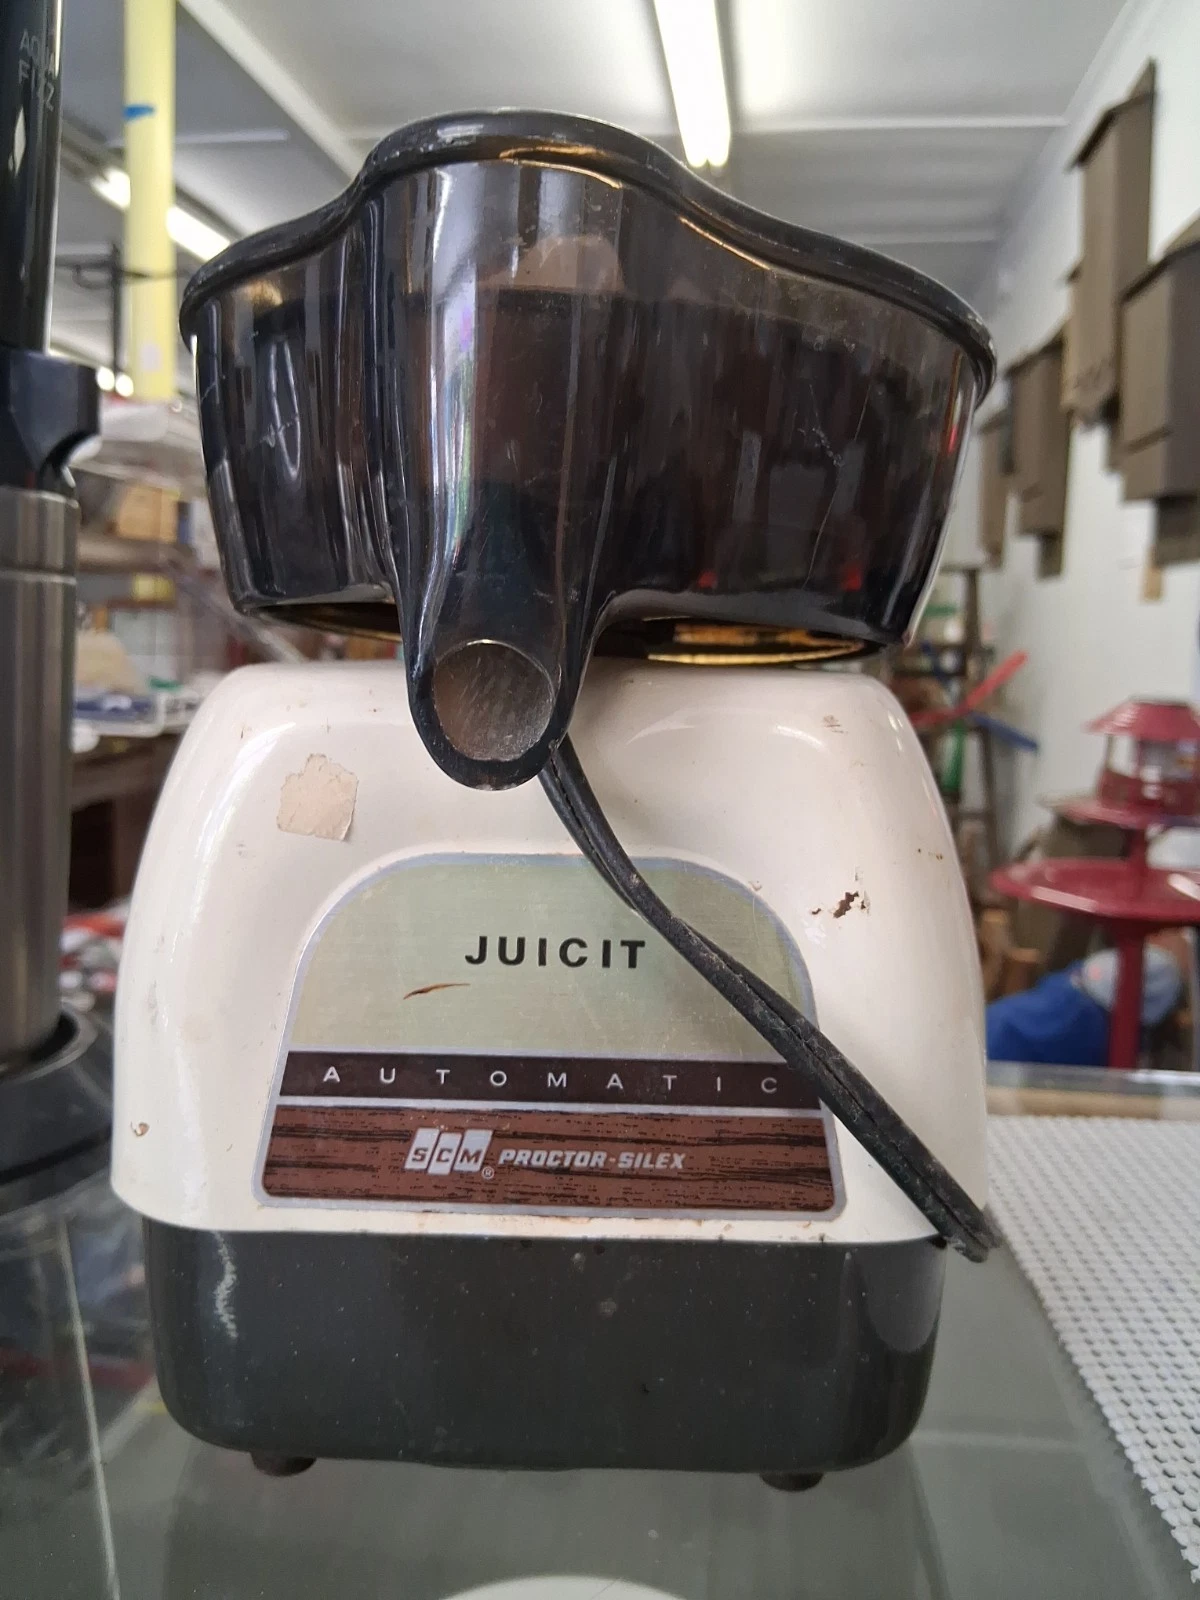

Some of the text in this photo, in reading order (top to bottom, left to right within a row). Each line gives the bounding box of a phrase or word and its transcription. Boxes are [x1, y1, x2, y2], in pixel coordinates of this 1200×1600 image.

[465, 936, 646, 969] JUICIT
[323, 1066, 778, 1093] AUTOMATIC
[498, 1148, 686, 1170] PROCTOR-SILEX
